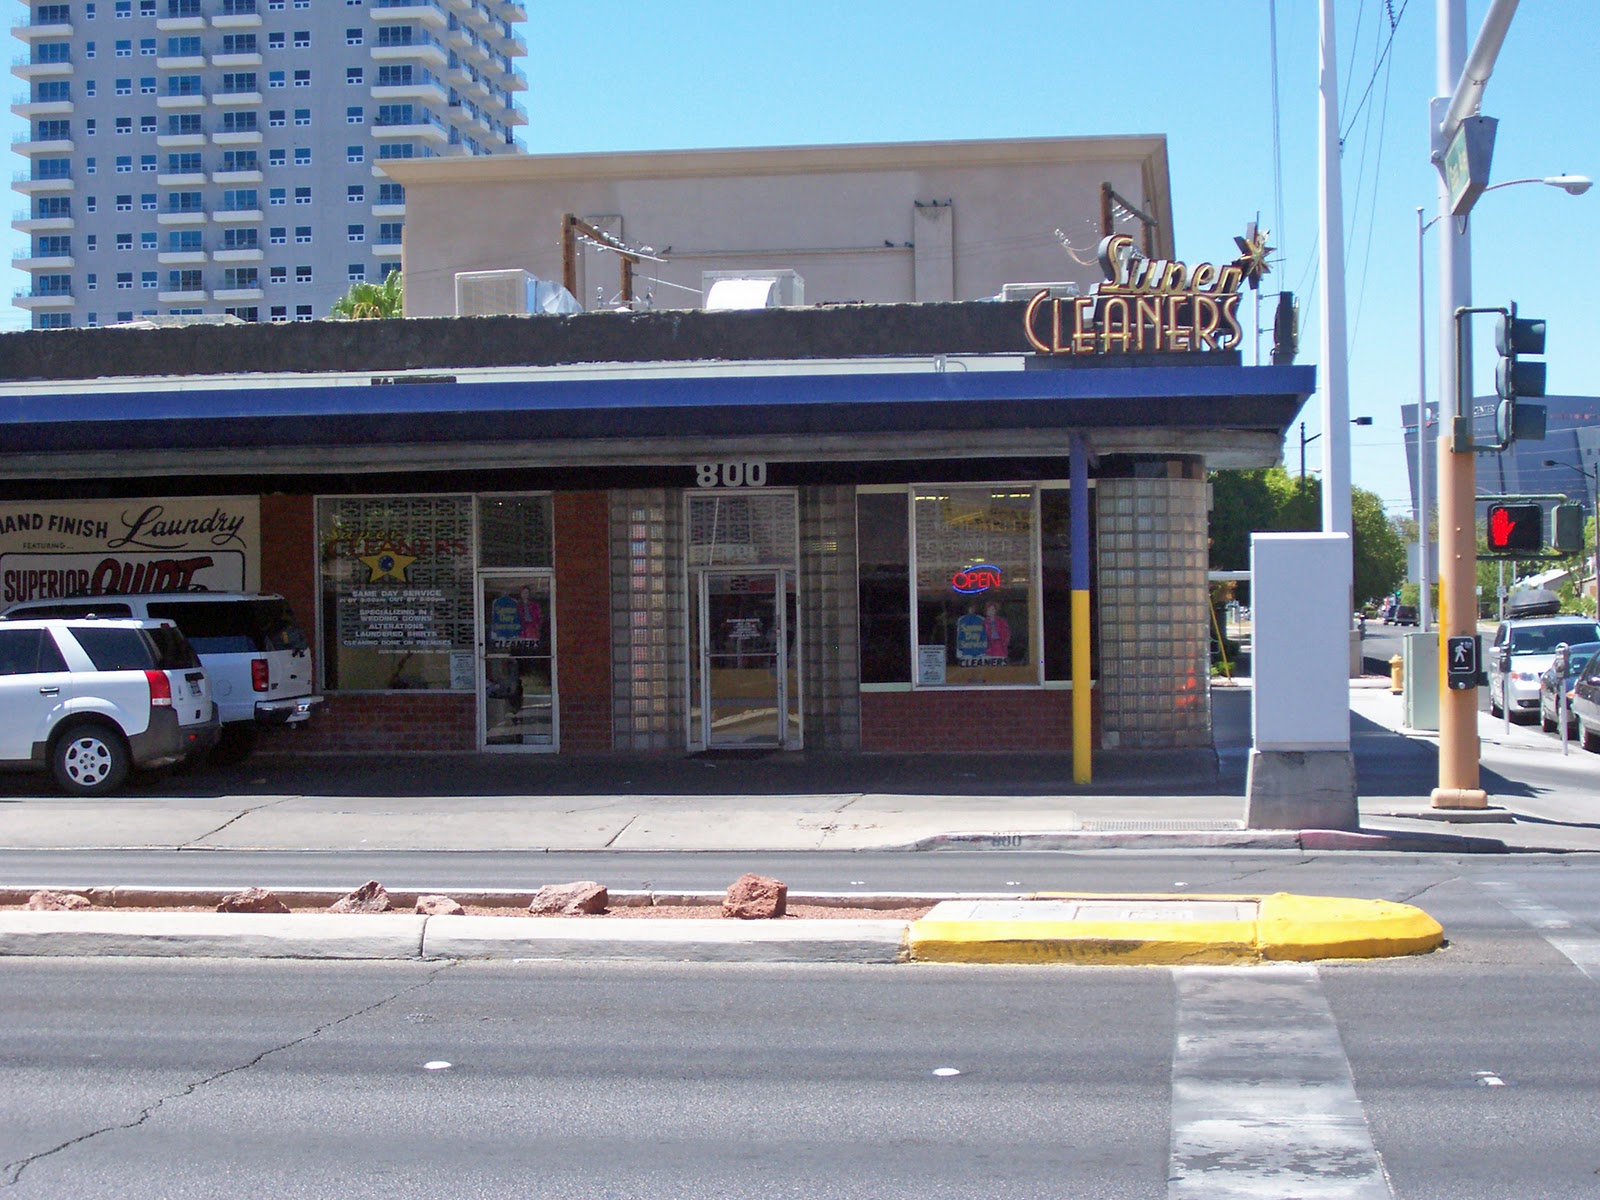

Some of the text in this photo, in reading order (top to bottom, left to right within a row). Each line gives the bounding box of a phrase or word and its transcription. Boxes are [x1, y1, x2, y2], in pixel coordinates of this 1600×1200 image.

[1099, 234, 1244, 294] Super
[1023, 288, 1243, 354] CLEANERS
[696, 462, 767, 487] 800
[48, 514, 108, 539] FINISH
[107, 505, 247, 549] Laundry
[4, 569, 89, 602] SUPERIOR
[952, 572, 1001, 588] OPEN
[352, 590, 377, 598] SAME
[402, 589, 442, 597] SERVICE
[494, 640, 540, 648] CLEANERS
[959, 658, 1009, 668] CLEANERS
